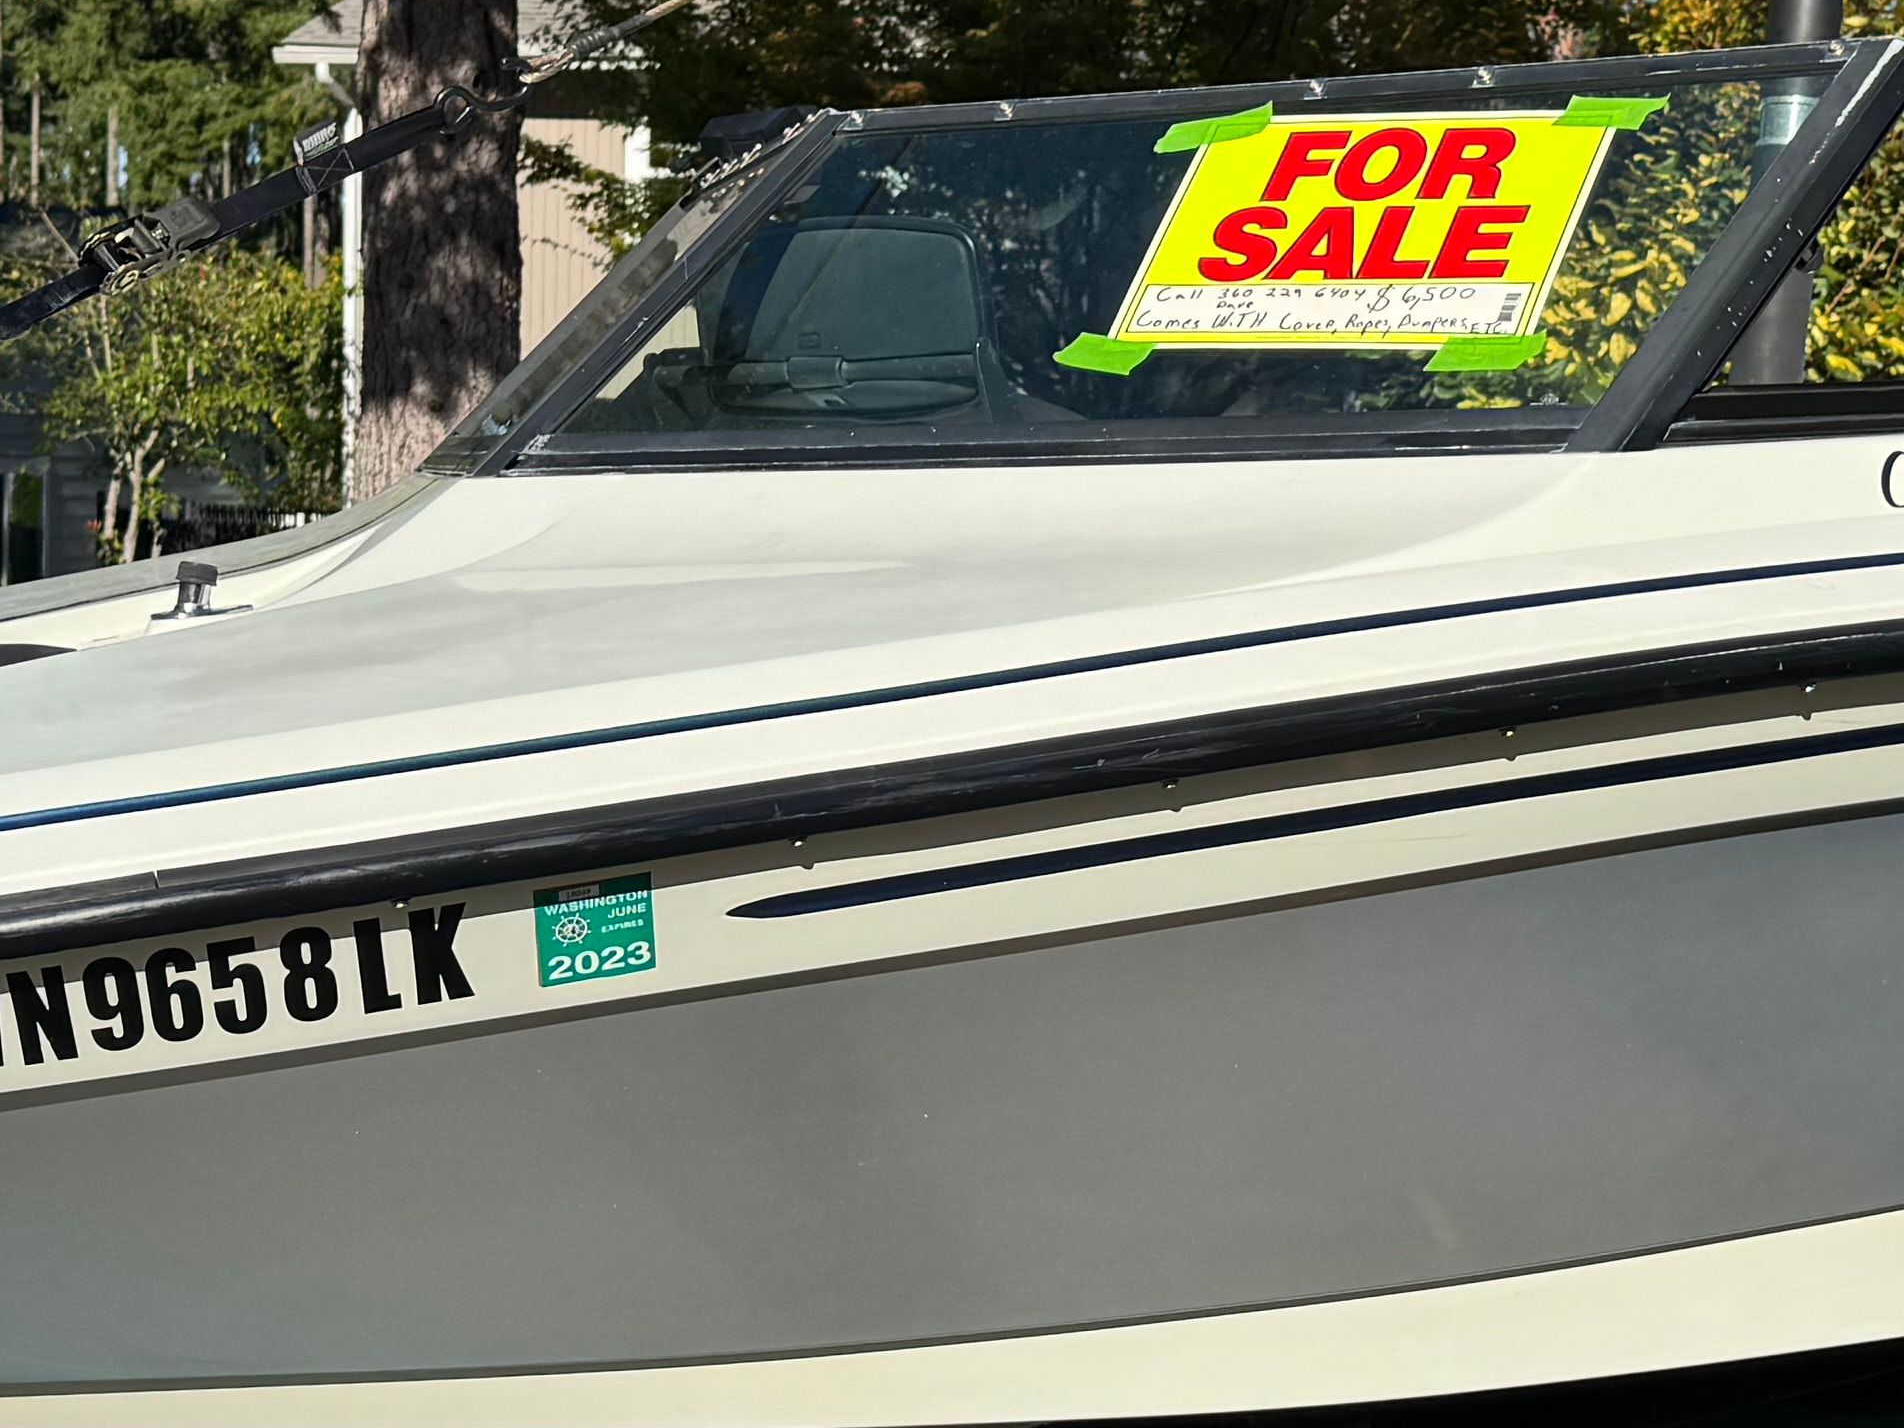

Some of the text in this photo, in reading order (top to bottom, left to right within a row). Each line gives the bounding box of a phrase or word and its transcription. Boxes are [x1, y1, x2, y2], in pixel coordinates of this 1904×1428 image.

[1258, 126, 1517, 201] FOR
[1197, 204, 1531, 281] SALE
[1156, 286, 1204, 302] Call
[1218, 287, 1254, 299] 360
[1266, 287, 1302, 299] 229
[1136, 310, 1200, 329] Comes
[544, 889, 648, 917] WASHINGTON
[607, 902, 647, 919] JUNE
[601, 918, 644, 934] EXPIRES
[547, 940, 651, 981] 2023
